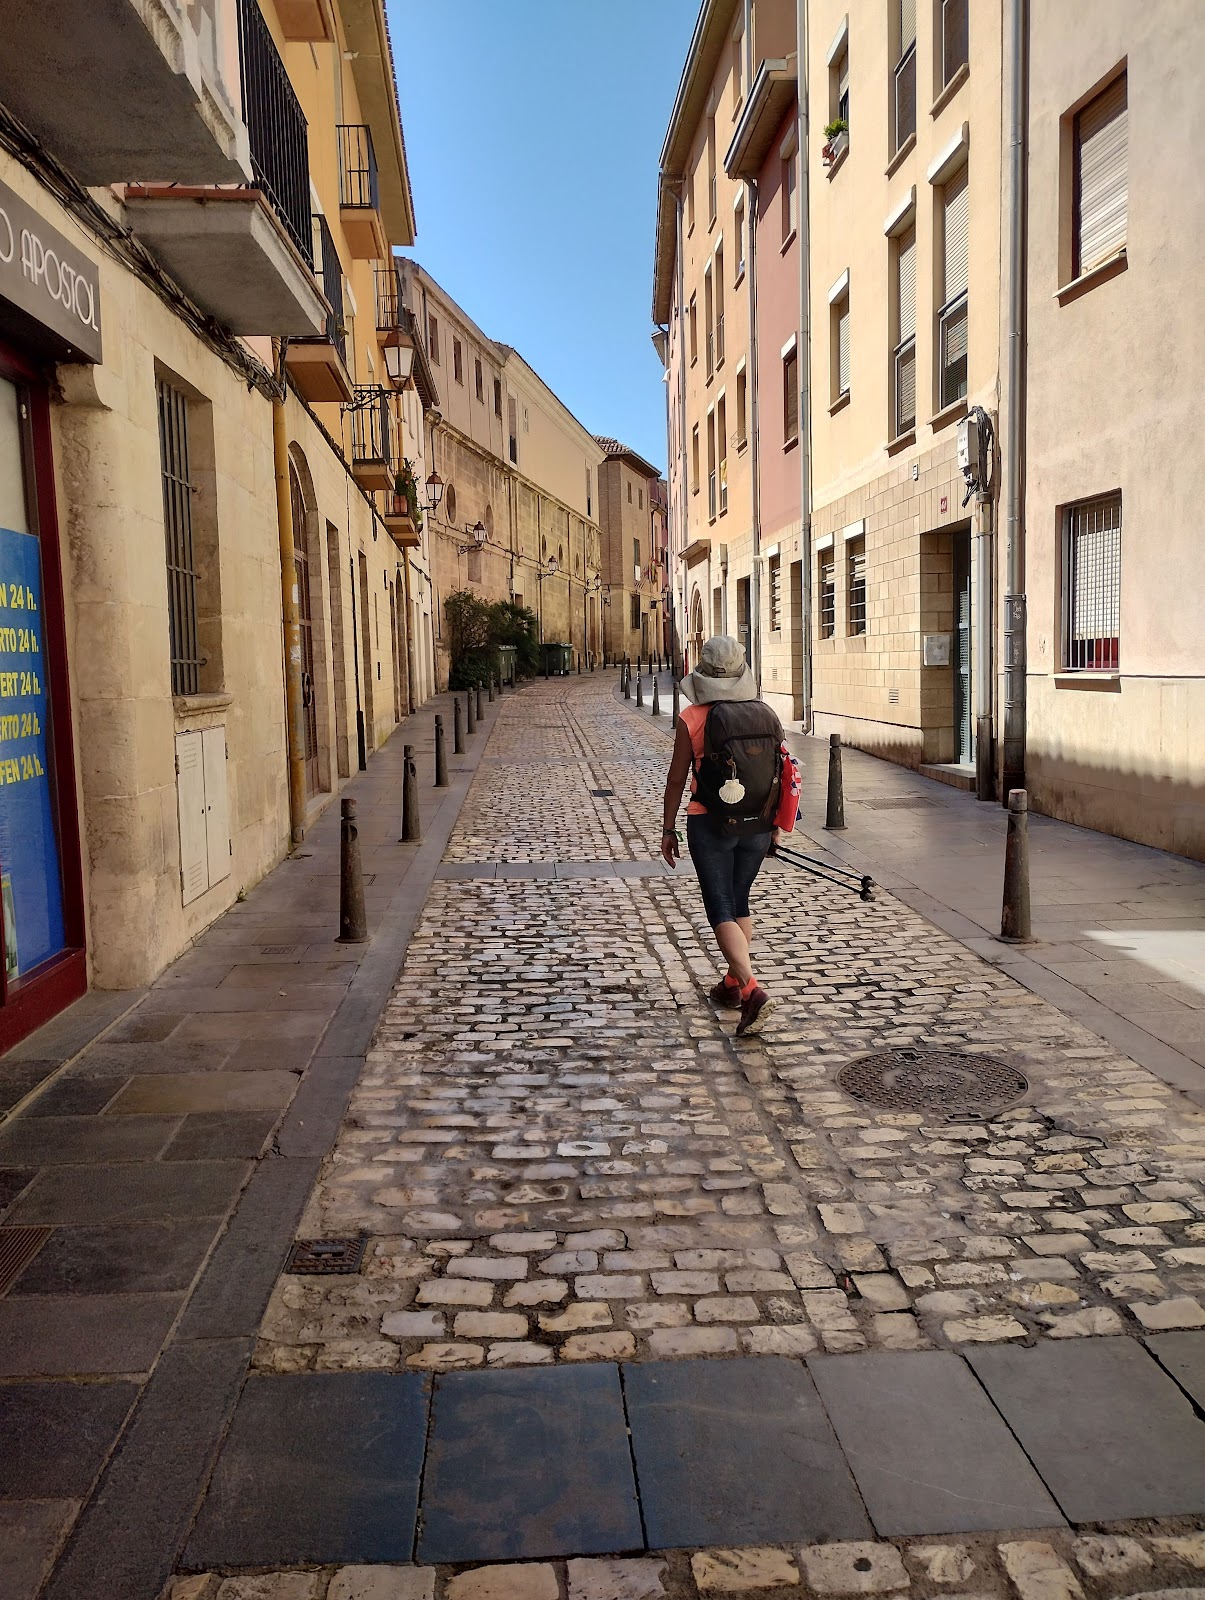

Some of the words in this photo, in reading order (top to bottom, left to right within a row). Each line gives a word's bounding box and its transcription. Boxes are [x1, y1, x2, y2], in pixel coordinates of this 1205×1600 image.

[21, 229, 98, 332] APOSTOL
[10, 584, 24, 608] 24
[27, 587, 36, 610] h.
[19, 629, 29, 652] 24
[31, 630, 39, 652] h.
[21, 671, 31, 696] 24
[33, 672, 40, 695] h.
[0, 714, 19, 743] RTO
[21, 713, 31, 737] 24
[33, 712, 40, 735] h.
[21, 756, 34, 780] 24
[33, 754, 44, 776] h.
